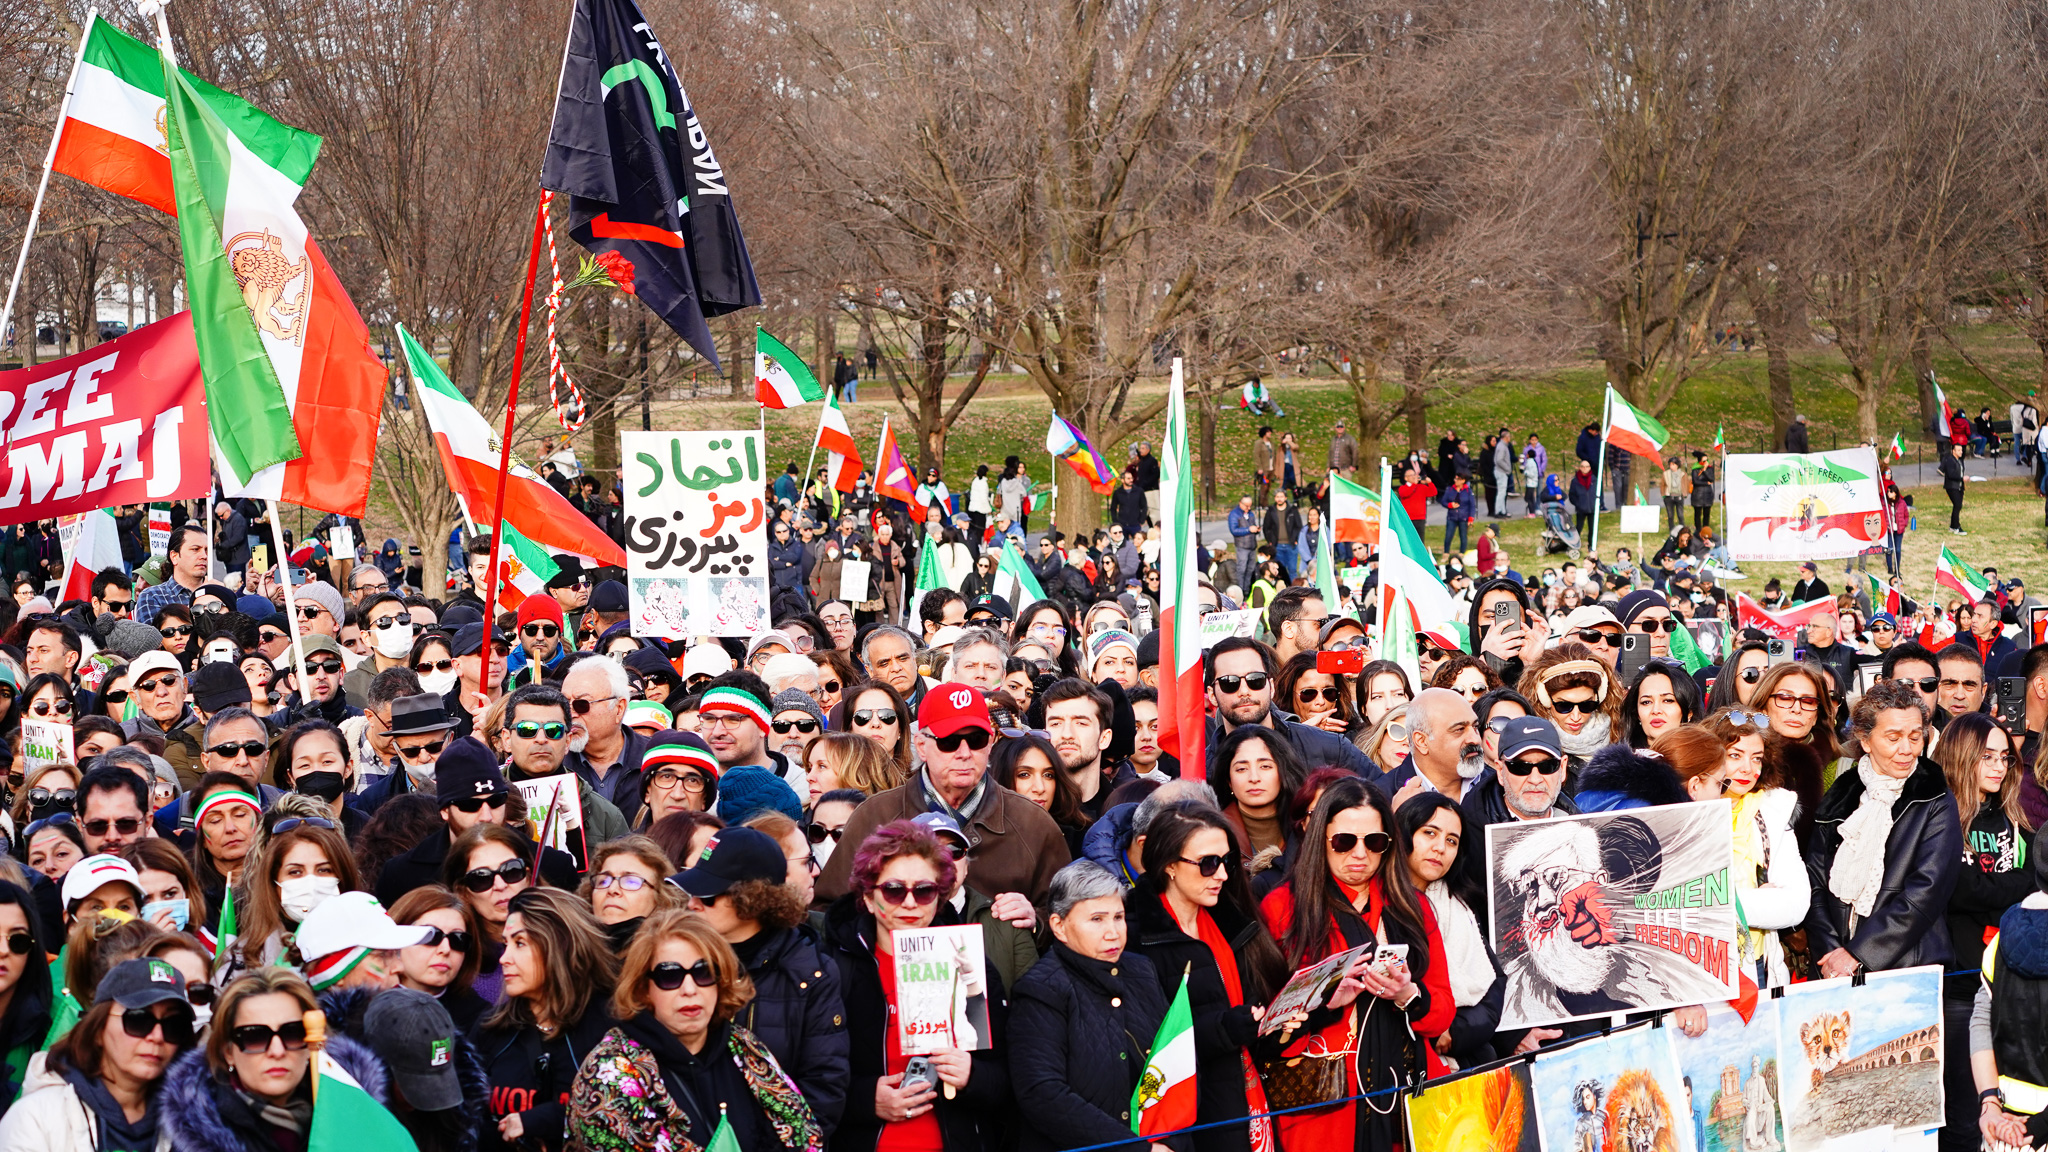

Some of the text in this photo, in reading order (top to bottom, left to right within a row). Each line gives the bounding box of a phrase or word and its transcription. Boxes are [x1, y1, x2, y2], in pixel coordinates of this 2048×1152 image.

[0, 405, 184, 510] MAJ
[636, 436, 759, 497] اتحاد
[1760, 467, 1856, 502] WOMEN LFE FREEDOM
[699, 491, 764, 538] رمز
[161, 541, 169, 550] IRA
[624, 510, 754, 576] پیروزی
[1830, 549, 1856, 558] REGIME
[1867, 546, 1883, 555] IRAN
[1202, 622, 1235, 633] IRAN
[1207, 613, 1232, 622] UNITY
[949, 688, 972, 710] W
[25, 724, 45, 738] UNITY
[25, 743, 54, 761] IRAN
[520, 785, 538, 799] ITY
[530, 804, 552, 822] AN
[1968, 830, 1999, 853] MEN
[1634, 866, 1729, 910] WOMEN
[1643, 908, 1701, 936] LIFE
[900, 936, 935, 953] UNITY
[1634, 923, 1730, 987] FREEDOM
[902, 962, 950, 983] IRAN
[905, 1019, 950, 1036] پیروزی
